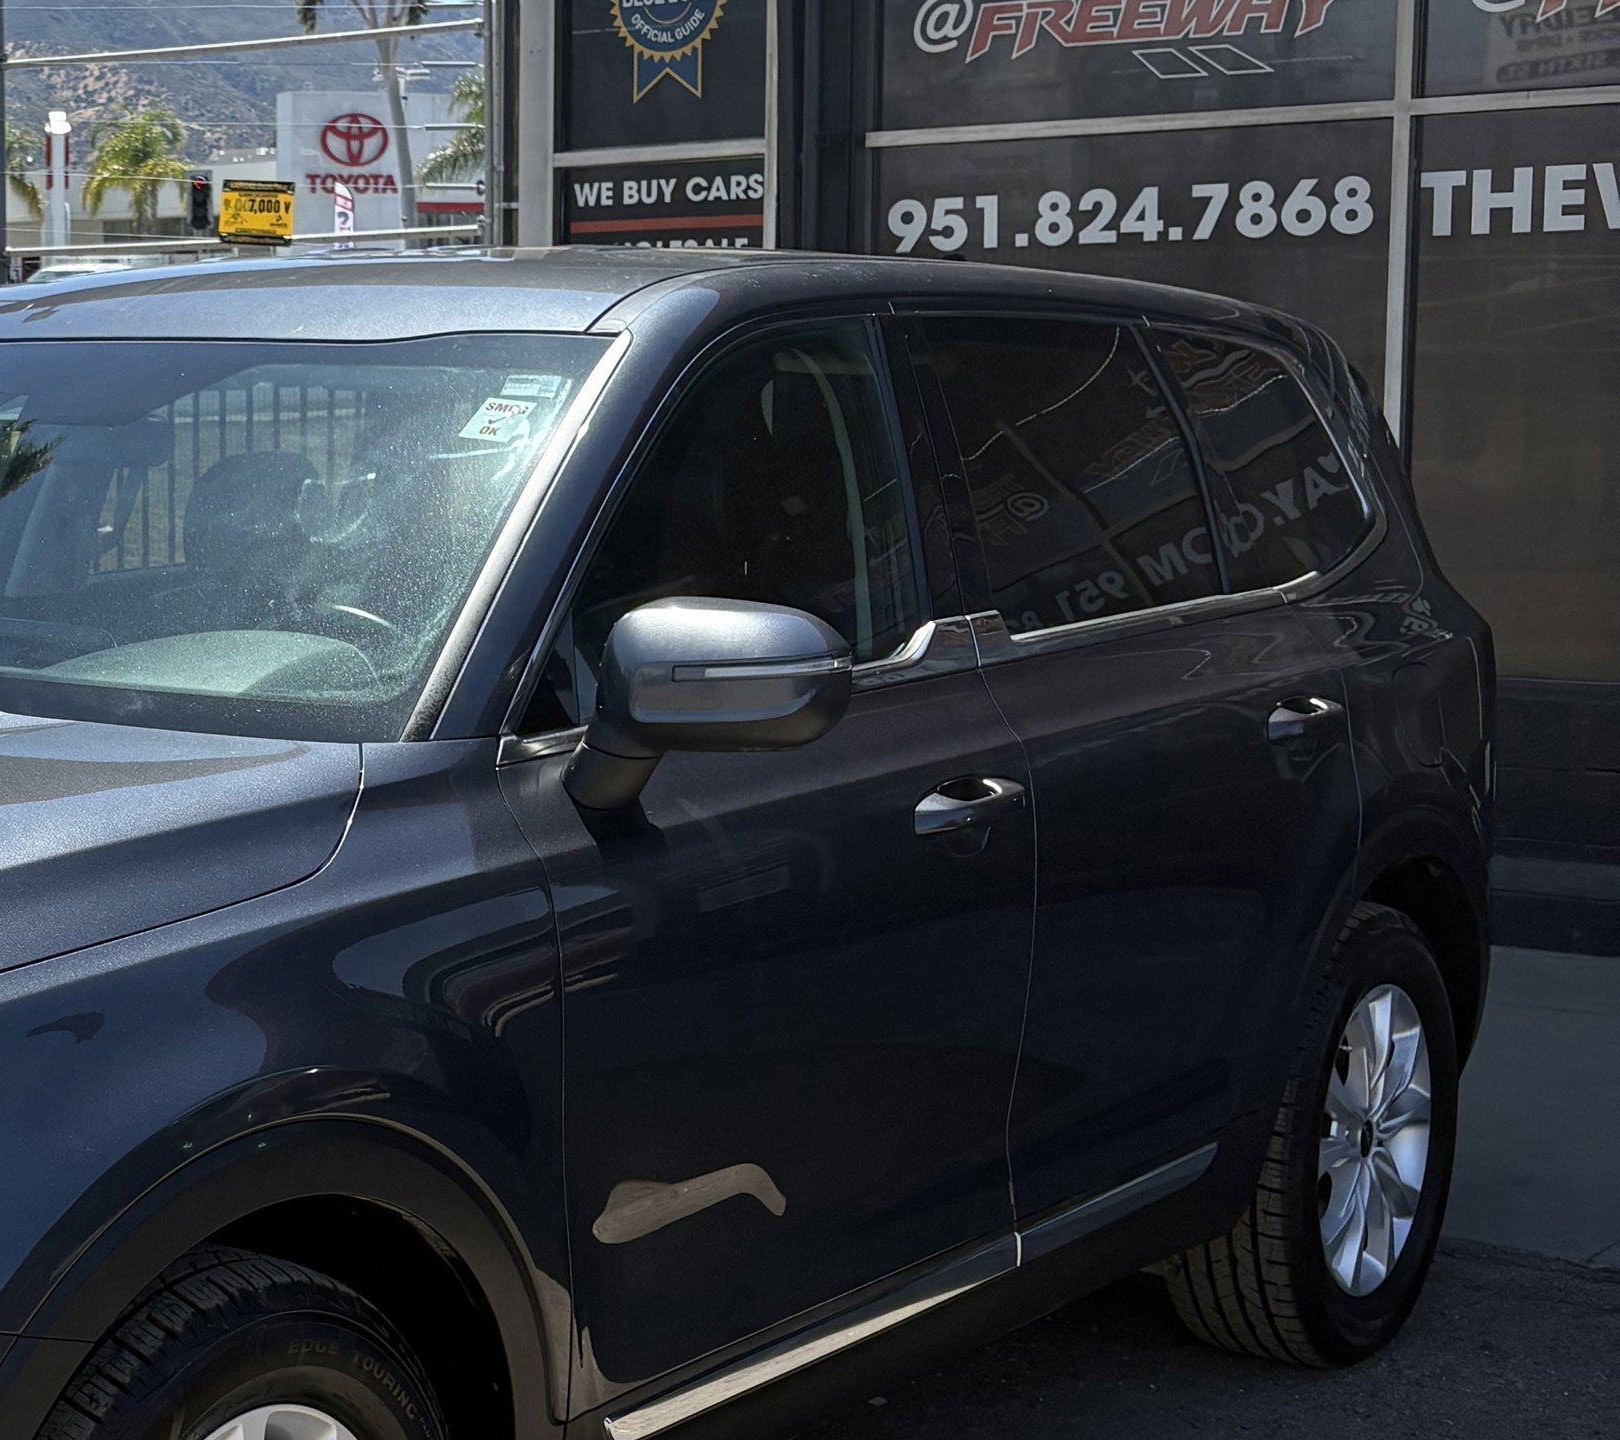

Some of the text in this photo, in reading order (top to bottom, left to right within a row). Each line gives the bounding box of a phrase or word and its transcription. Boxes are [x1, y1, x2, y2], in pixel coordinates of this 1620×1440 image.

[631, 8, 706, 43] OFFICIAL GUIDE
[305, 173, 398, 195] TOYOTA
[573, 173, 764, 209] WE BUY CARS
[248, 199, 280, 215] 7,000
[887, 175, 1374, 254] 951.824.7868
[479, 426, 500, 436] OK
[287, 1339, 340, 1356] EDGE
[351, 1349, 418, 1421] TOURING
